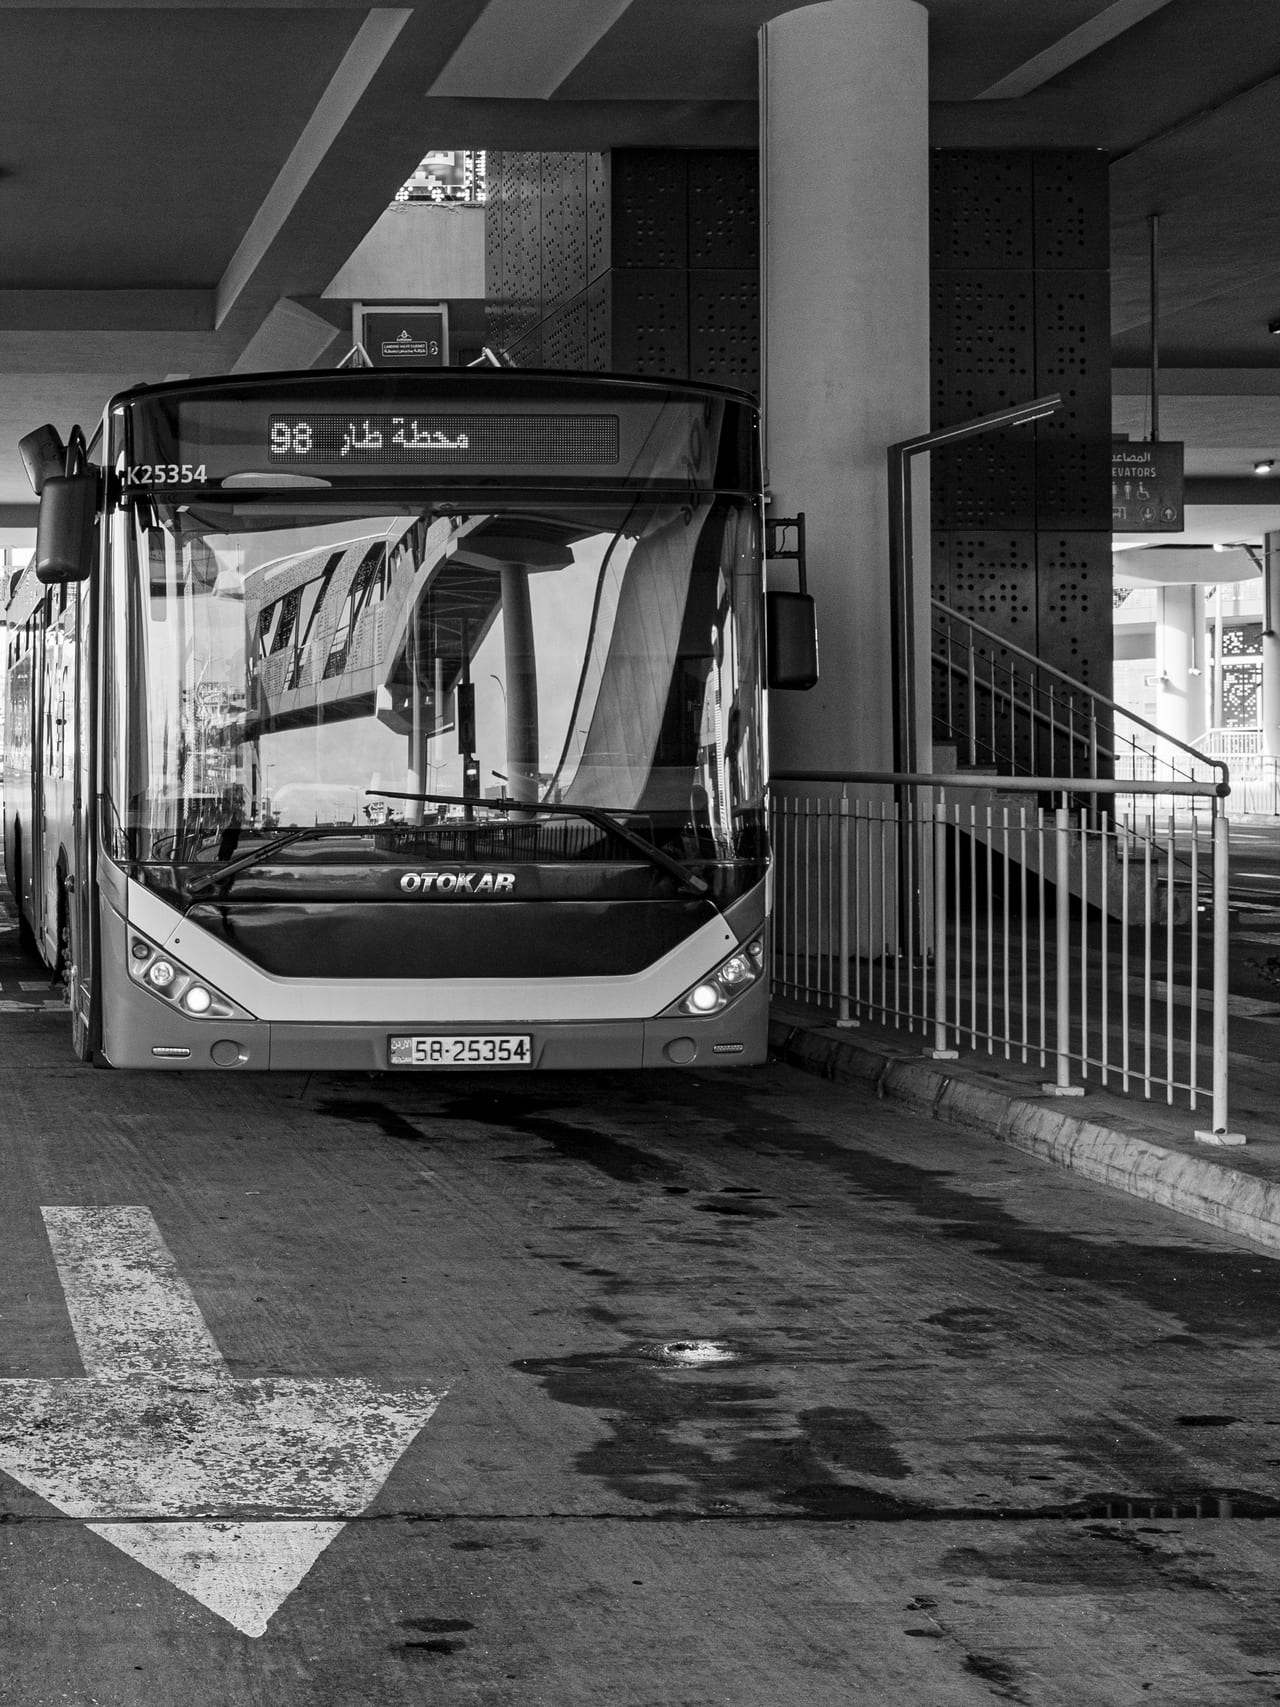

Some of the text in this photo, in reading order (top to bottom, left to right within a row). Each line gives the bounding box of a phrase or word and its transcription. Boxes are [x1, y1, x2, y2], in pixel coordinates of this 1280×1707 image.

[271, 422, 313, 454] 98
[391, 417, 469, 450] محطة
[127, 463, 208, 486] K25354
[1112, 467, 1156, 477] EVATORS
[400, 872, 516, 893] OTOKAR
